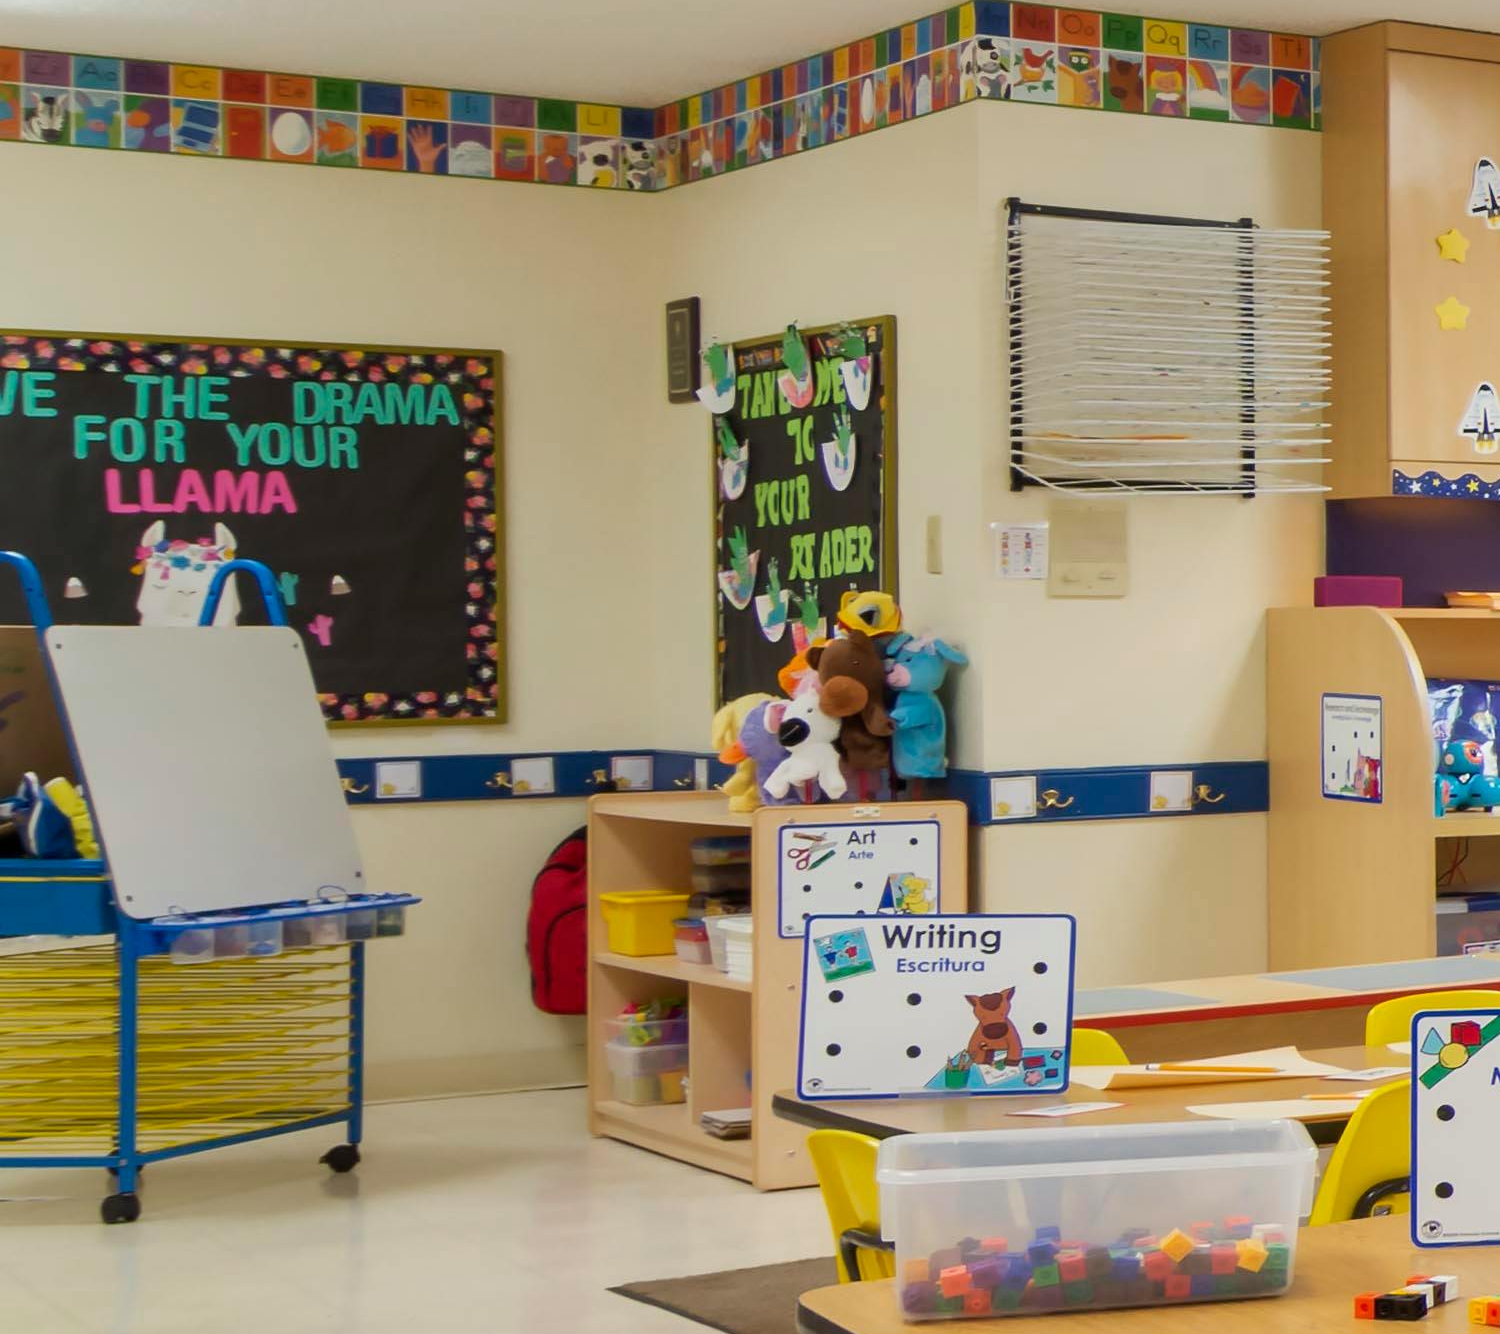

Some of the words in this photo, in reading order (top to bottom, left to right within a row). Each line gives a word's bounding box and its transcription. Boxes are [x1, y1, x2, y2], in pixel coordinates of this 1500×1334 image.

[124, 374, 230, 420] THE
[293, 382, 460, 425] DRAMA
[73, 415, 186, 463] FOR
[226, 422, 359, 468] YOUR
[786, 414, 815, 465] TO
[105, 468, 298, 514] LLAMA
[754, 474, 811, 528] YOUR
[846, 829, 876, 846] Art
[848, 849, 874, 860] Arte
[882, 923, 1002, 954] Writing
[896, 957, 985, 973] Escritura
